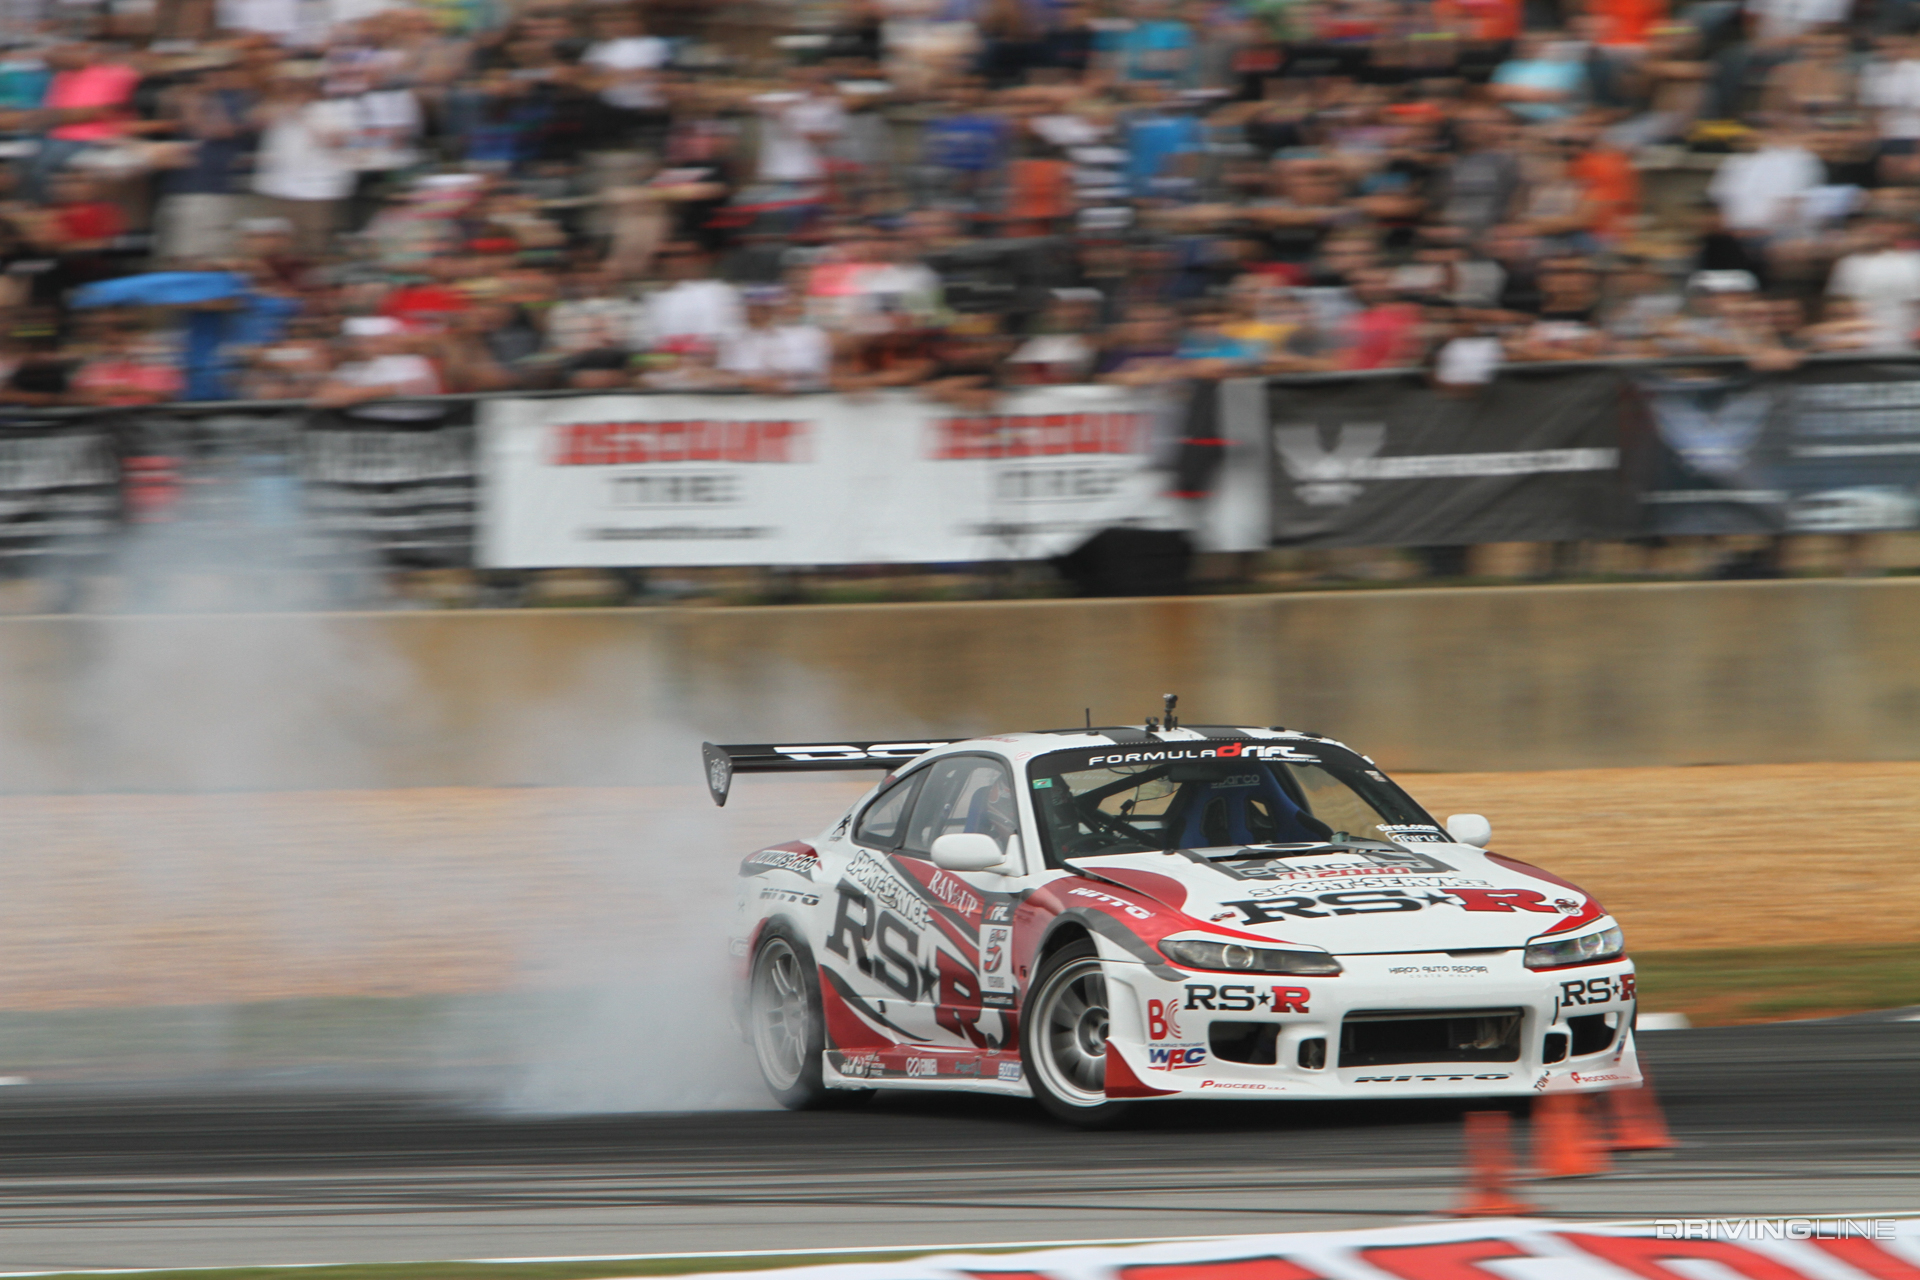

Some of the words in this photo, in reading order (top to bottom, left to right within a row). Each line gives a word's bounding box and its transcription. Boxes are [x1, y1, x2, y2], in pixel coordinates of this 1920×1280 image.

[1089, 749, 1216, 766] FORMULA
[759, 887, 820, 906] NITTO
[1067, 887, 1152, 920] NITTO
[1200, 1080, 1266, 1090] PROCEED
[1354, 1073, 1511, 1083] NITTO
[1571, 1072, 1619, 1084] PROCEED
